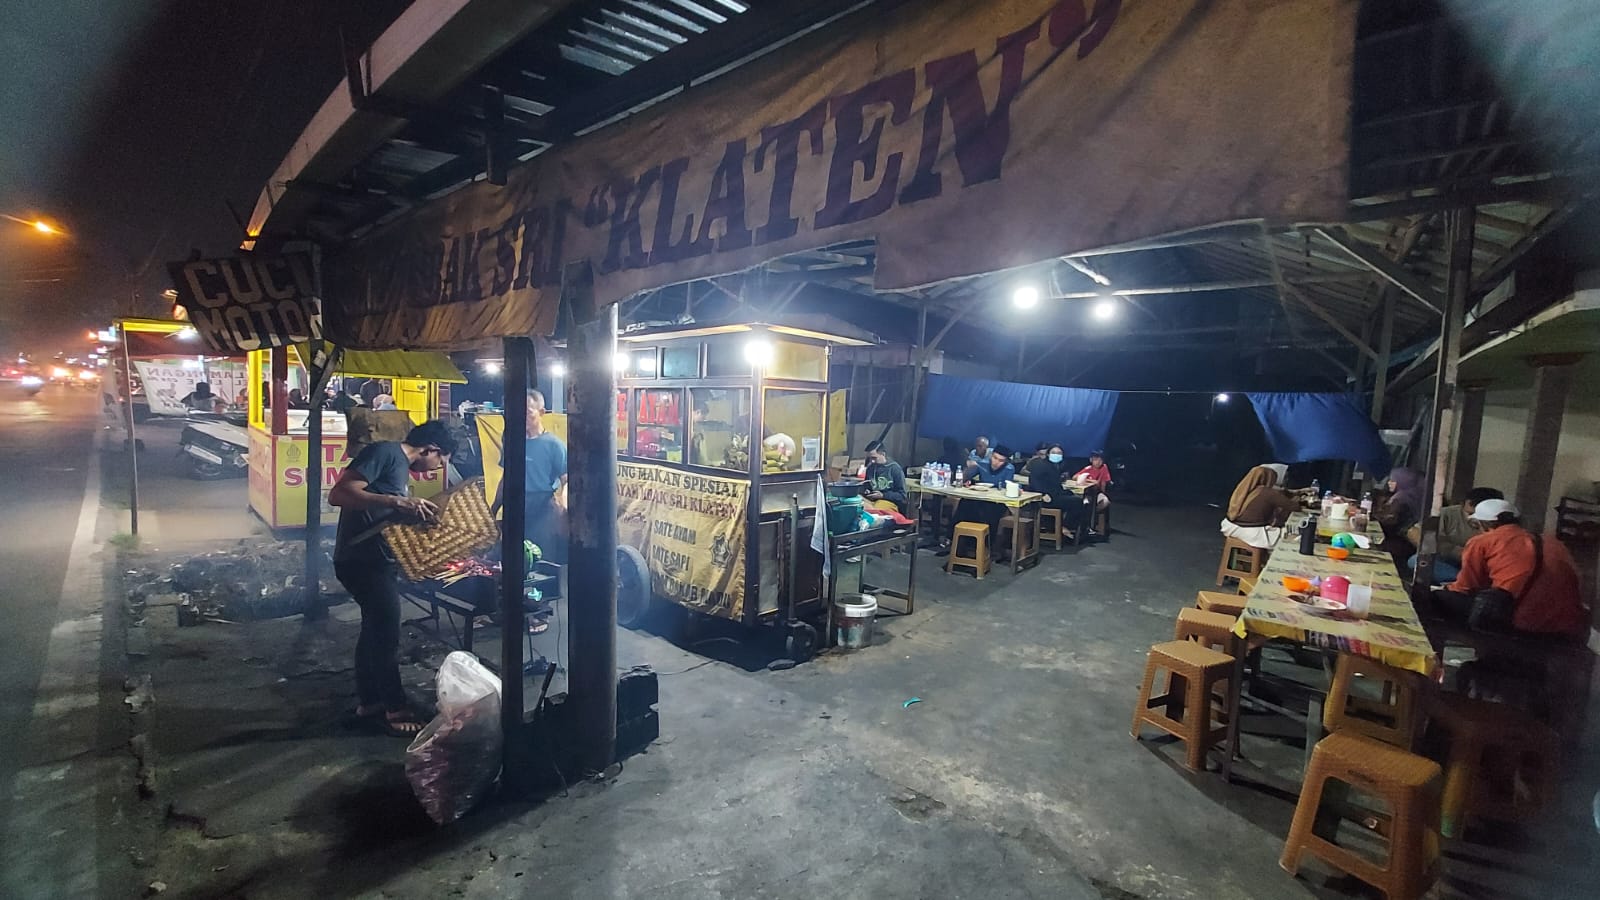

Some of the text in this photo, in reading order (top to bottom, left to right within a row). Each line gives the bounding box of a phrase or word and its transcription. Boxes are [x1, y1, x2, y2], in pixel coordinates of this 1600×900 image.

[183, 256, 317, 309] CUCI
[189, 297, 323, 352] MOTOR
[638, 467, 682, 488] MAKAN
[683, 476, 739, 498] SPESIAL
[654, 519, 697, 545] SATE AYAM
[651, 544, 690, 572] SATE SAPI
